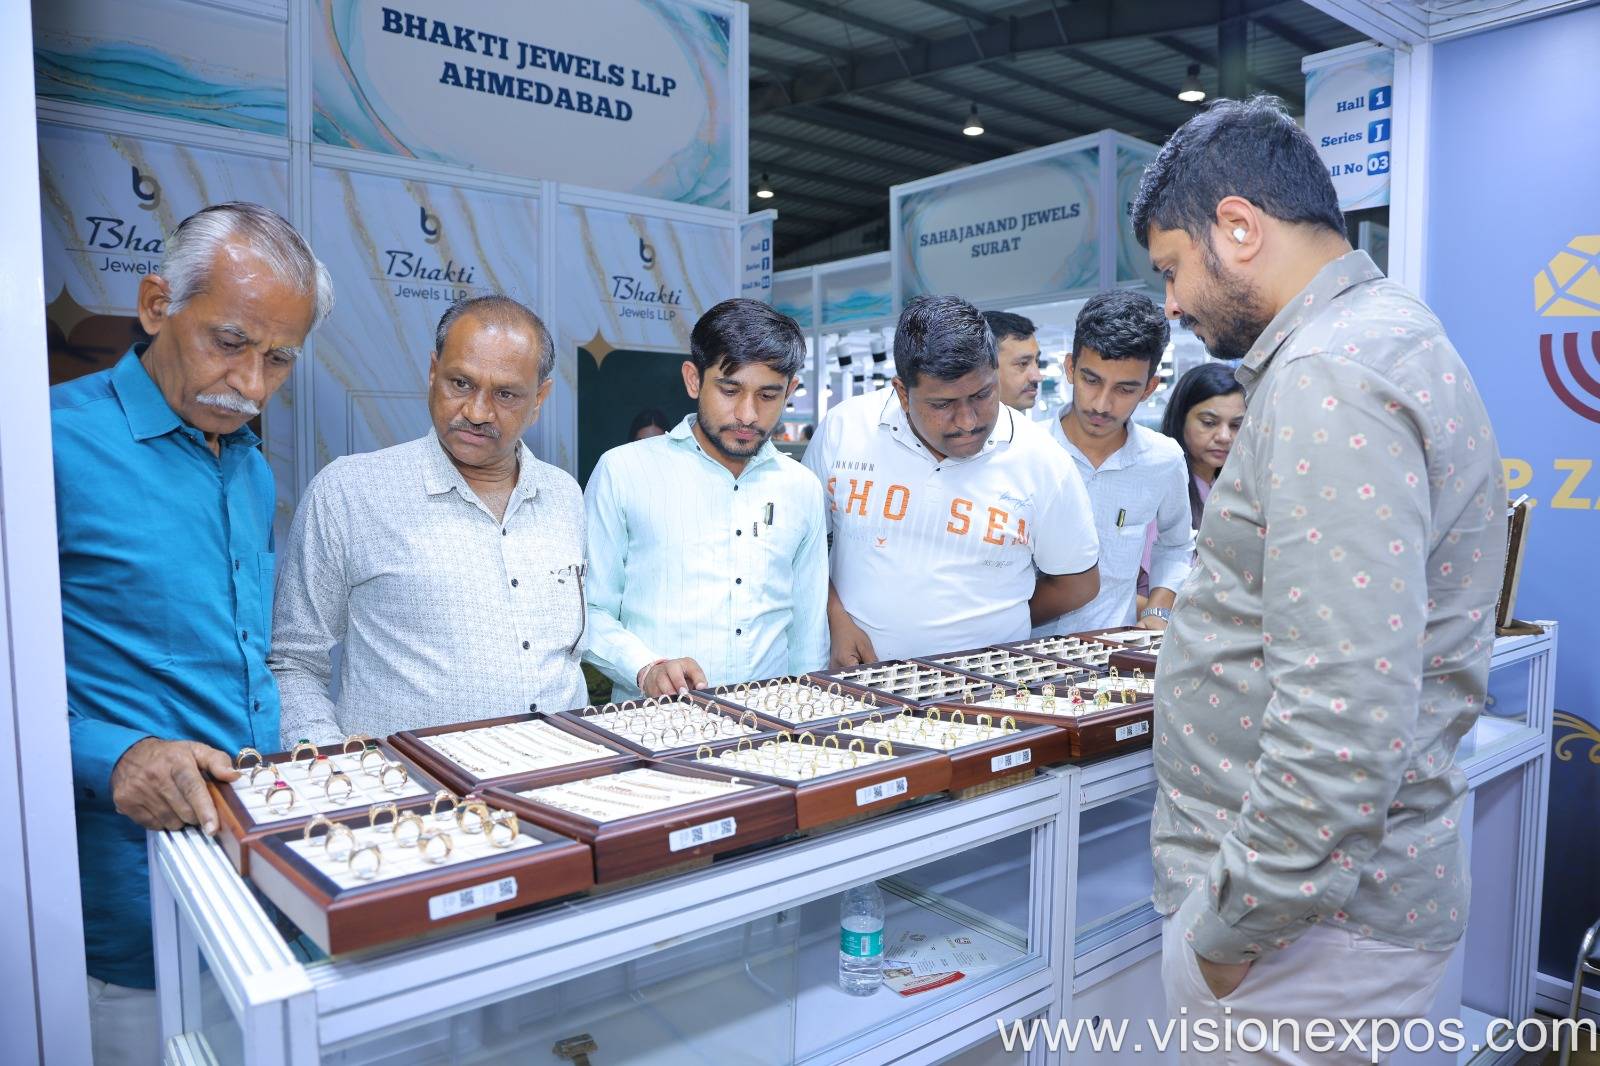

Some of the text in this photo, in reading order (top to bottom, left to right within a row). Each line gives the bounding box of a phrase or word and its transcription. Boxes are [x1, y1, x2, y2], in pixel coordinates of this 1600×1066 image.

[381, 6, 677, 97] BHAKTI JEWELS LLP
[439, 61, 633, 122] AHMEDABAD
[1336, 91, 1385, 113] Hall 1
[1321, 124, 1384, 148] Series J
[1344, 162, 1363, 175] No
[1368, 156, 1389, 171] 03
[920, 203, 1081, 248] SAHAJANAND JEWELS
[971, 237, 1021, 258] SURAT
[385, 250, 475, 284] Bhakti
[395, 285, 468, 303] Jewels LLP
[612, 275, 682, 305] Bhakti
[618, 306, 676, 321] Jewels LLP
